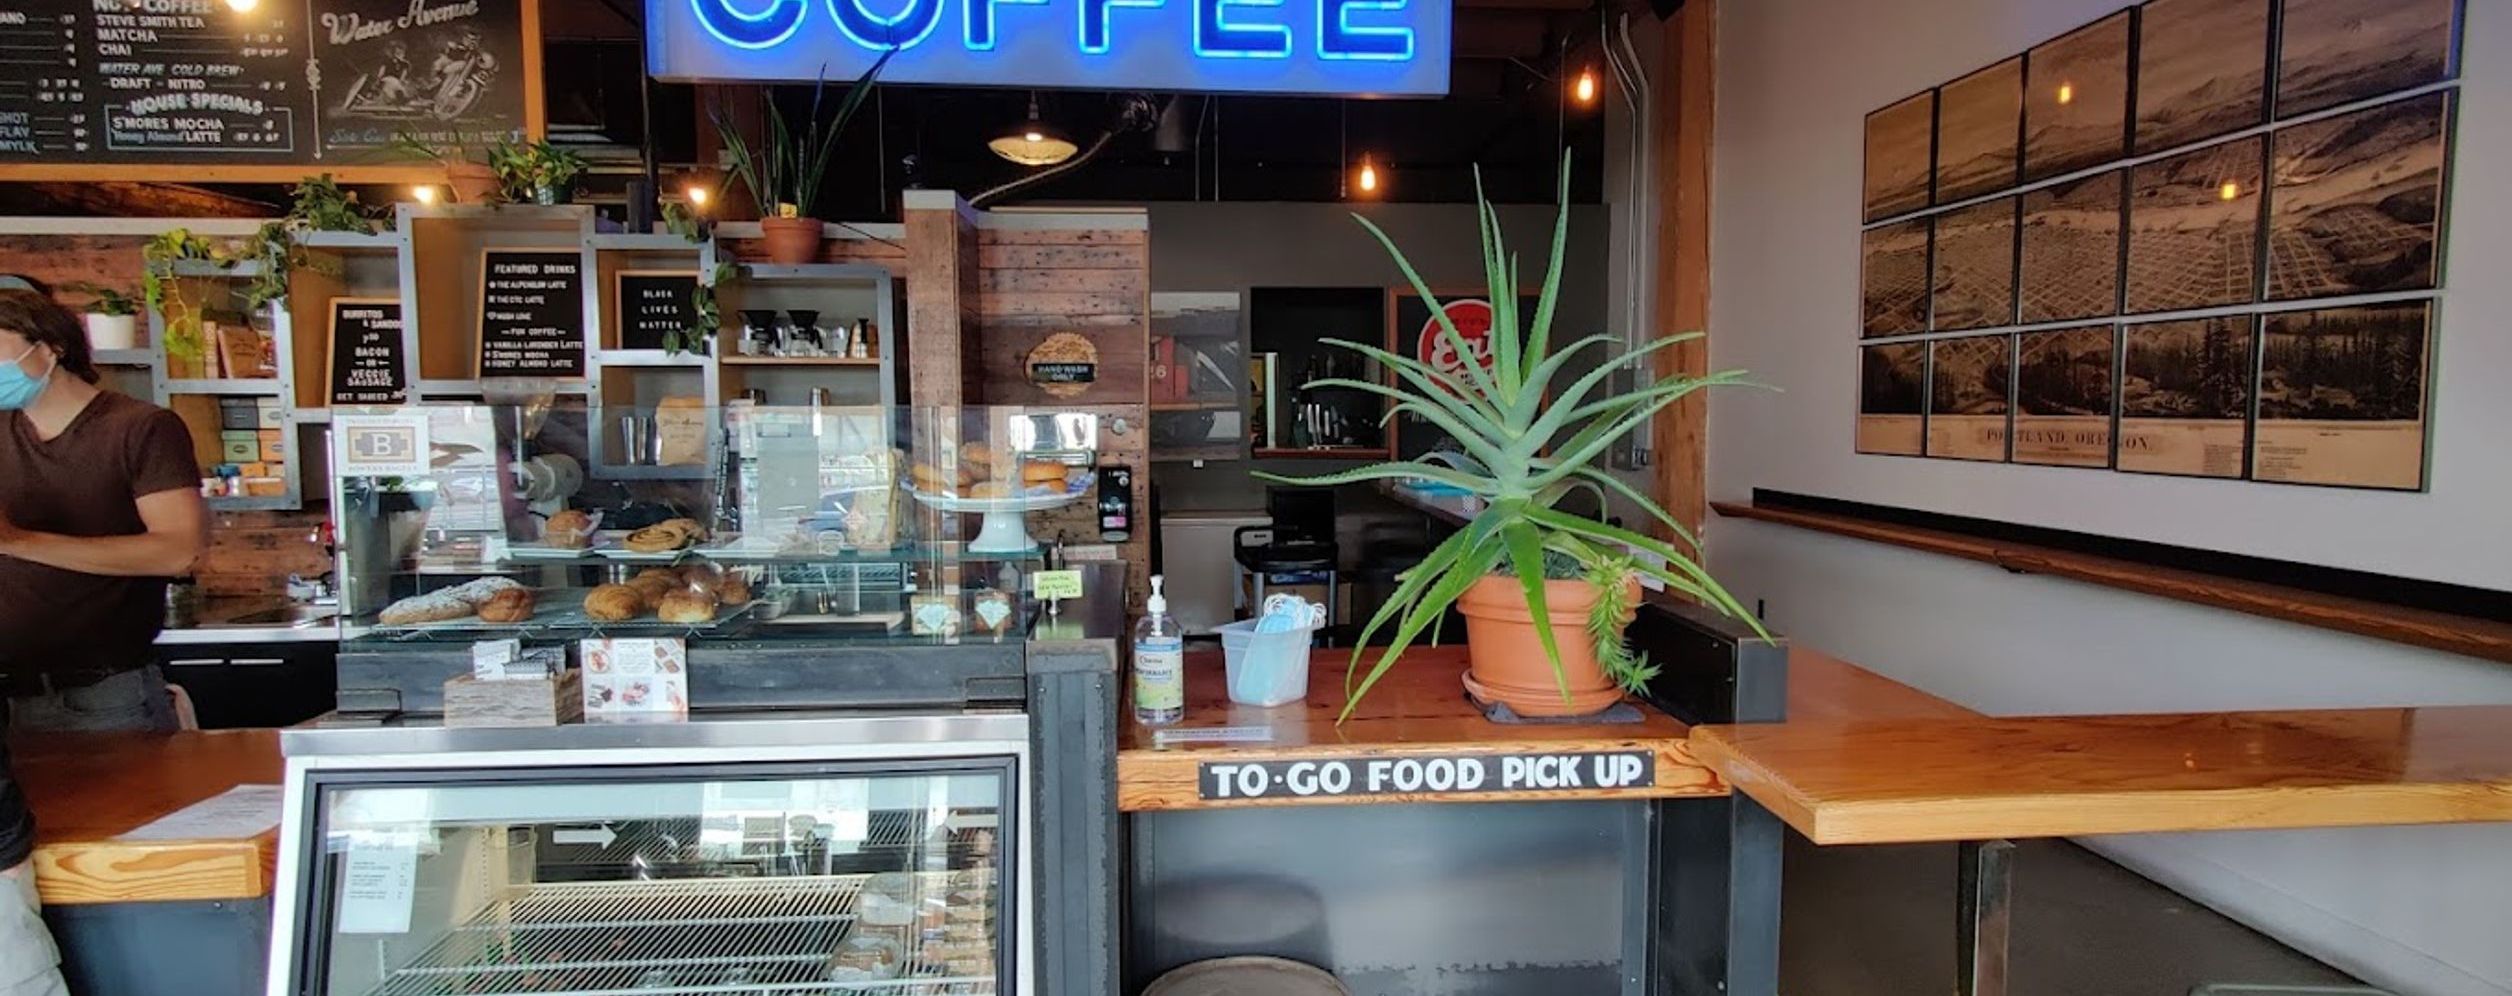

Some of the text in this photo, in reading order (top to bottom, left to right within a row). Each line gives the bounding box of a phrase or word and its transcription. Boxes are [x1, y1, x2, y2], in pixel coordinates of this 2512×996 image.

[96, 14, 206, 29] STEVE SMITH TEA
[320, 11, 395, 45] Water
[97, 28, 159, 42] MATCHA
[98, 43, 132, 56] CHAI
[171, 63, 204, 77] COLD
[109, 77, 207, 91] DRAFT NITRO
[129, 92, 264, 116] HOUSE SPECIALS
[173, 117, 225, 131] MOCHA
[185, 131, 221, 143] LATTE
[494, 264, 577, 275] FEATURED DRINKS
[354, 346, 390, 358] BACON
[371, 433, 392, 455] B
[1367, 758, 1486, 792] FOOD
[1501, 755, 1583, 788] PICK
[1593, 754, 1644, 788] UP
